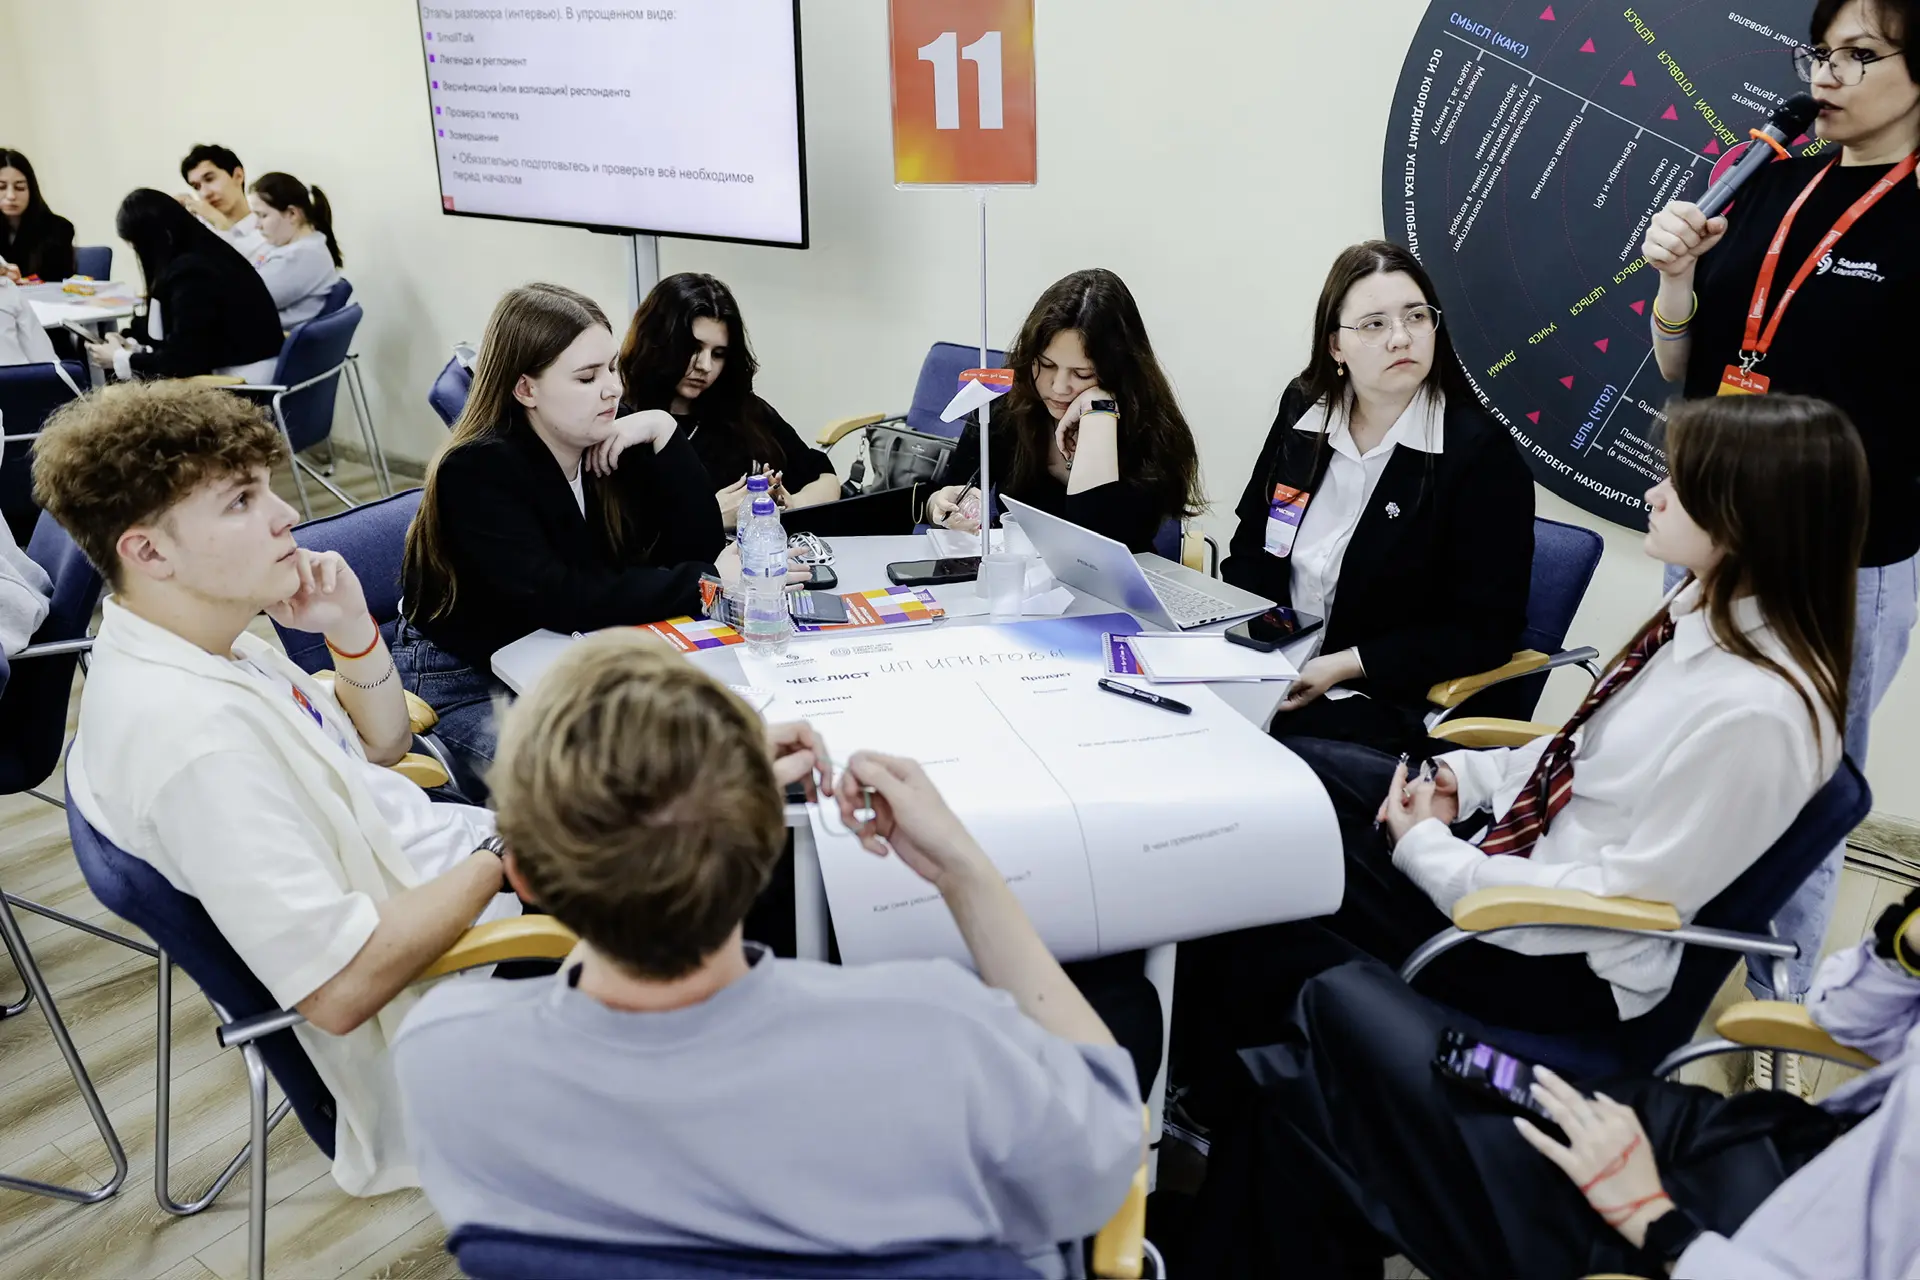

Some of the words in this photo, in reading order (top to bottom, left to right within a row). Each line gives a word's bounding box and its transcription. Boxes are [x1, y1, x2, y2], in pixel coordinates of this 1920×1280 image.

[422, 6, 452, 20] Этапы
[454, 8, 502, 21] разговора
[565, 6, 574, 20] В
[576, 8, 644, 22] упрощенном
[646, 8, 677, 22] виде:
[1623, 7, 1656, 45] ЦЕЛЬСЯ
[1728, 12, 1774, 37] провалов
[436, 31, 474, 43] SmallTalk
[1450, 12, 1491, 39] СМЫСЛ
[1491, 31, 1529, 59] (КАК?)
[1773, 33, 1799, 48] опыт
[440, 54, 474, 66] Легенда
[475, 56, 482, 66] и
[482, 57, 527, 67] регламент
[1427, 48, 1443, 74] ОСИ
[1457, 60, 1473, 86] идею
[1657, 50, 1697, 97] ГОТОВЬСЯ
[442, 80, 498, 93] Верификация
[569, 86, 631, 98] респондента
[917, 31, 1003, 129] 11
[1450, 86, 1461, 97] за
[1463, 65, 1485, 100] Можете
[1743, 81, 1778, 102] делать
[445, 106, 486, 119] Проверка
[1408, 76, 1433, 149] КООРДИНАТ
[1491, 82, 1518, 129] зародился
[1507, 88, 1529, 124] лучшей
[1731, 92, 1767, 114] можете
[448, 129, 500, 142] Завершение
[1431, 106, 1451, 136] минуту
[1440, 100, 1466, 145] рассказать
[1499, 94, 1542, 165] Использованные
[1555, 114, 1584, 156] Понятная
[1693, 98, 1739, 146] ДЕЙСТВУЙ
[1474, 129, 1495, 160] термин
[1486, 123, 1511, 162] практике
[459, 151, 519, 168] Обязательно
[521, 158, 591, 173] подготовьтесь
[592, 163, 600, 173] и
[601, 163, 655, 178] проверьте
[657, 165, 677, 179] всё
[679, 168, 754, 184] необходимое
[1404, 153, 1417, 198] УСПЕХА
[1606, 140, 1637, 184] Бенчмарк
[1649, 158, 1669, 185] смысл
[453, 170, 481, 184] перед
[482, 172, 522, 186] началом
[1481, 165, 1503, 199] понятия
[1530, 157, 1558, 200] семантика
[1602, 184, 1611, 193] и
[1652, 163, 1681, 208] понимают
[1466, 195, 1474, 203] в
[1593, 192, 1608, 209] KPI
[1645, 207, 1654, 216] и
[1448, 202, 1470, 236] которой
[1618, 215, 1649, 262] разделяют
[1569, 286, 1606, 316] ЦЕЛЬСЯ
[1528, 322, 1558, 345] УЧИСЬ
[1486, 350, 1517, 378] ДУМАЙ
[1570, 421, 1594, 450] ЦЕЛЬ
[1588, 384, 1618, 420] (ЧТО?)
[1614, 438, 1654, 465] масштаба
[1619, 427, 1655, 452] Понятен
[1509, 425, 1533, 448] ВАШ
[1531, 444, 1573, 476] ПРОЕКТ
[1573, 471, 1643, 508] НАХОДИТСЯ
[786, 671, 870, 685] ЧЕК-ЛИСТ
[1020, 671, 1072, 682] Продукт
[794, 694, 853, 706] Клиенты
